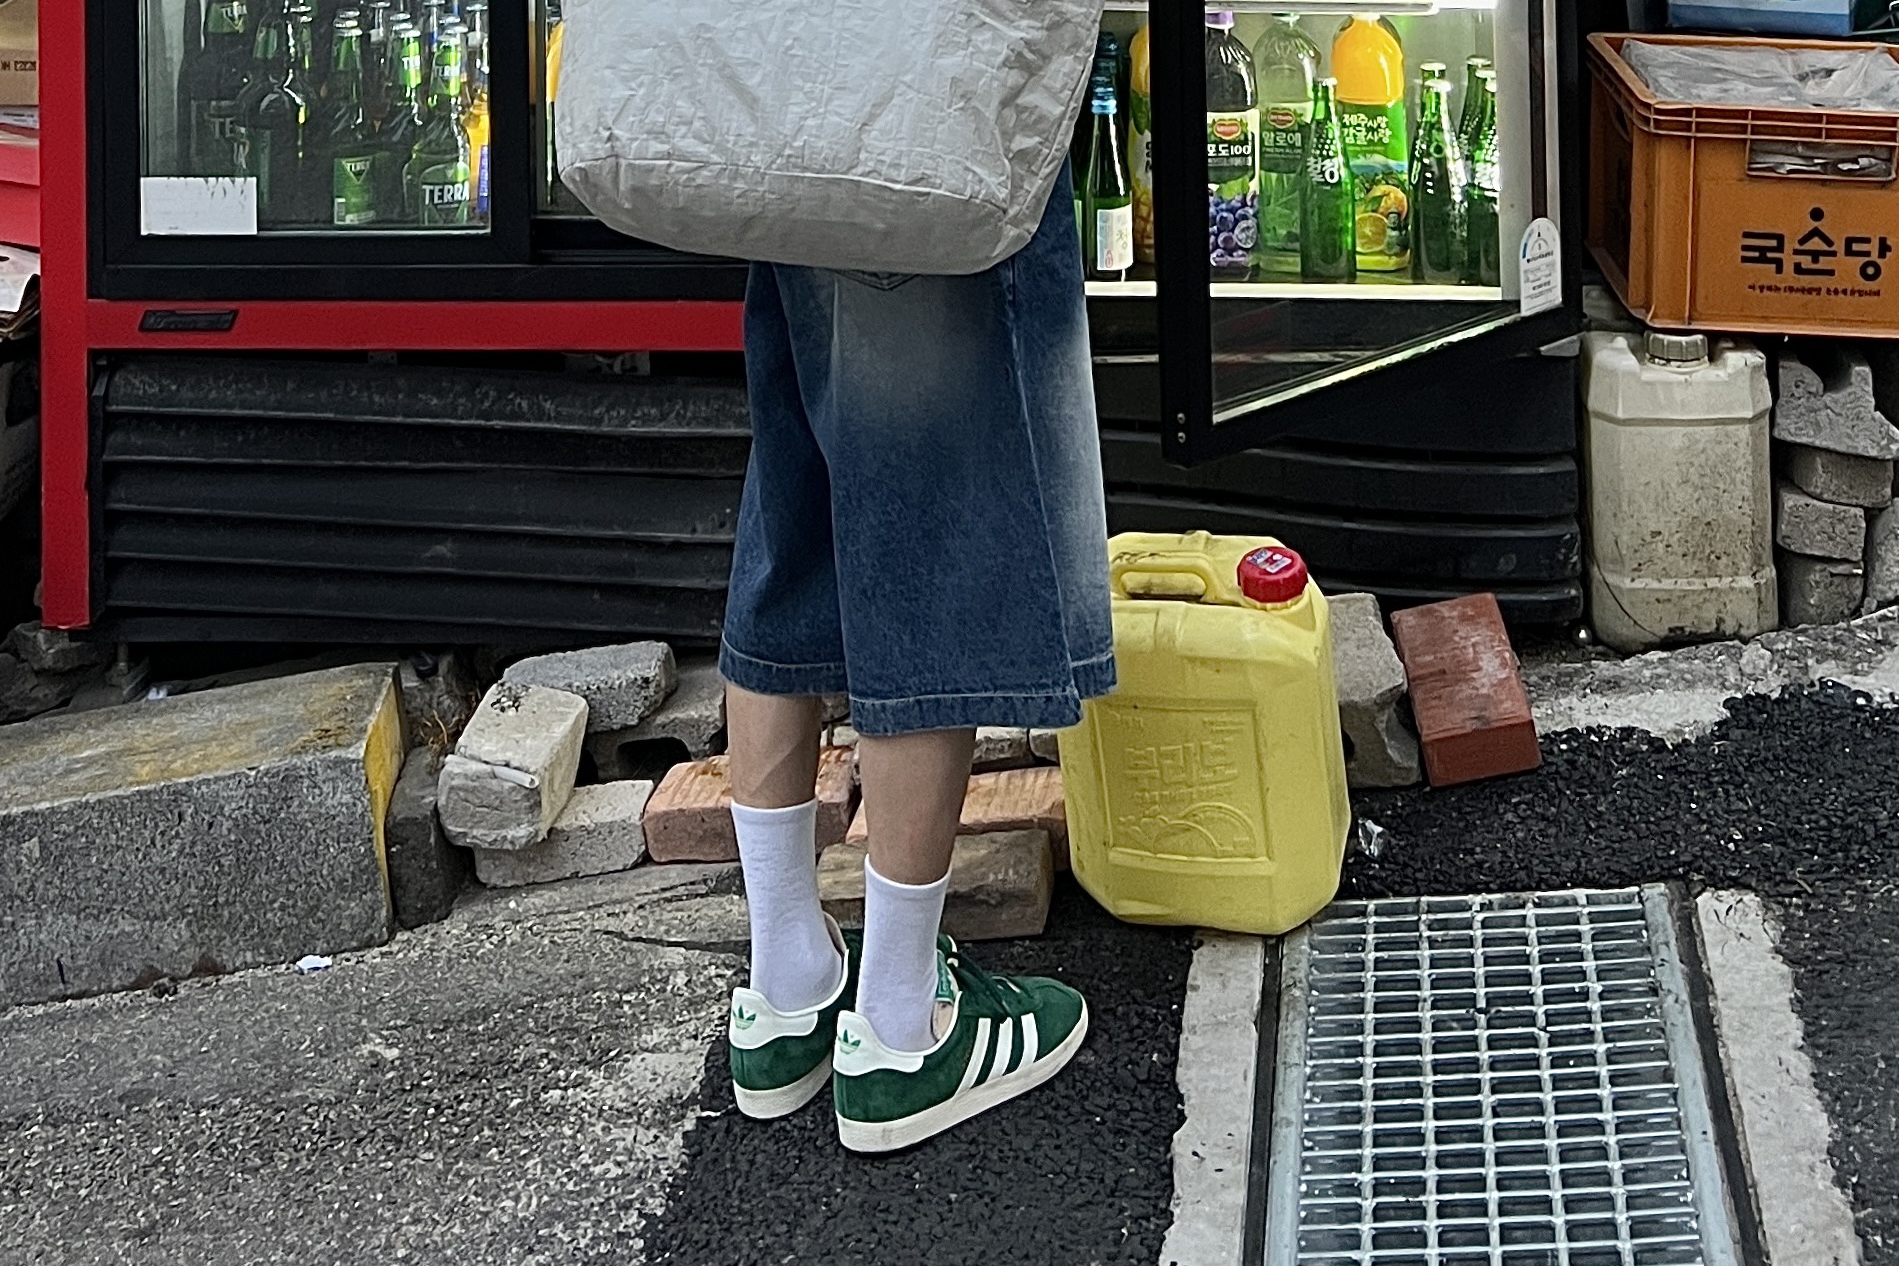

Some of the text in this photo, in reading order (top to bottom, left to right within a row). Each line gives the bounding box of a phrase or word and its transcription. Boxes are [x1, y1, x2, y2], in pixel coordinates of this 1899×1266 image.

[1342, 113, 1389, 129] 제주사랑
[1262, 132, 1302, 147] 알로에
[1342, 127, 1393, 145] 감귤사랑
[421, 183, 470, 205] TERRA
[1740, 206, 1893, 283] 국순당
